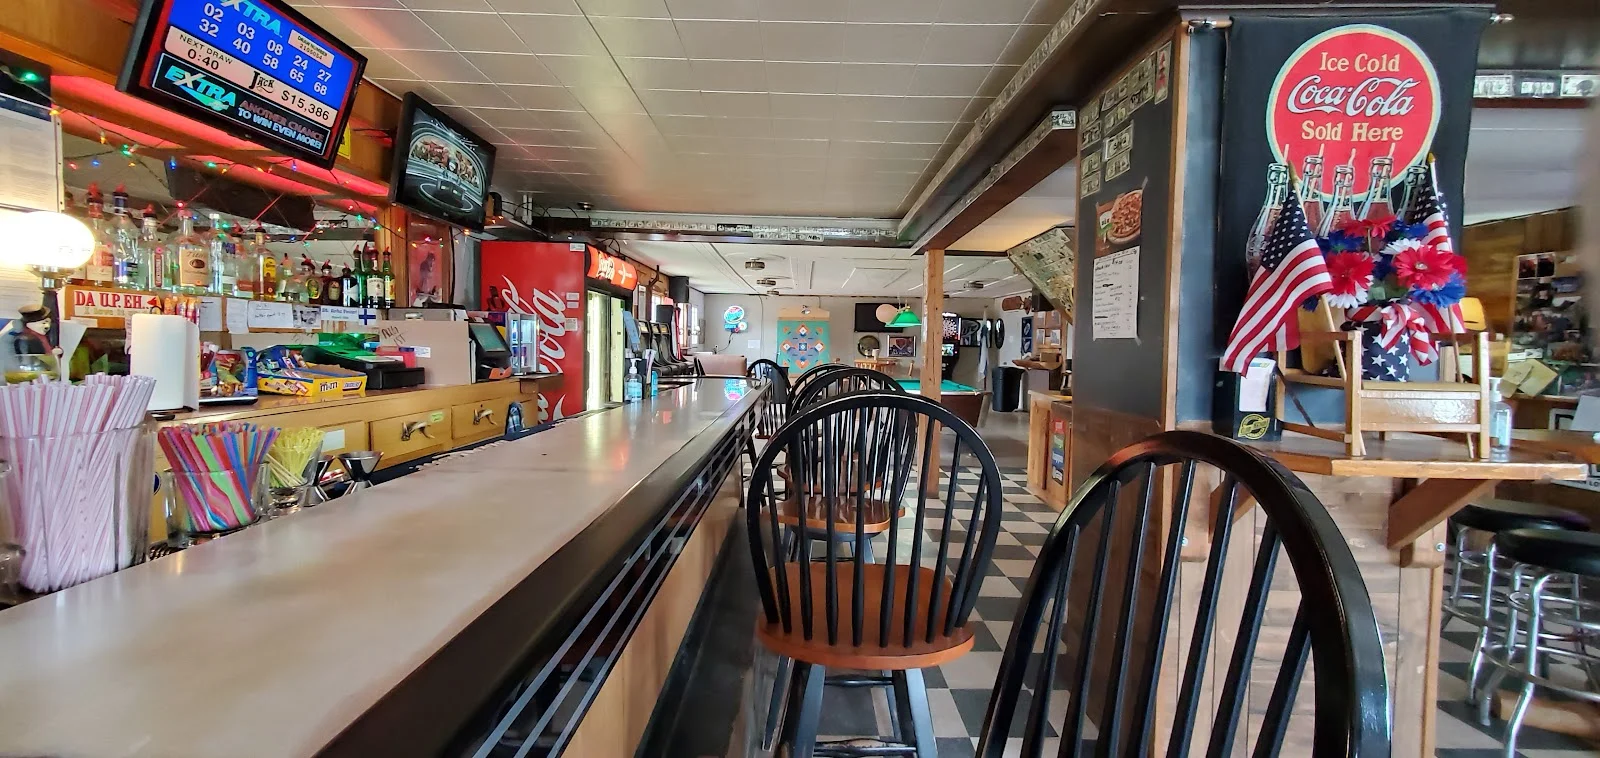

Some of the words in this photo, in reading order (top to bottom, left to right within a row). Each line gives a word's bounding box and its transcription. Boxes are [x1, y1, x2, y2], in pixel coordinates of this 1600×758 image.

[220, 0, 283, 37] XTRA
[179, 33, 205, 51] NEXT
[205, 46, 233, 65] DRAW
[199, 18, 220, 38] 32
[233, 37, 251, 54] 40
[262, 53, 279, 70] 58
[289, 67, 305, 84] 65
[313, 80, 328, 96] 68
[203, 2, 224, 23] 02
[237, 22, 255, 40] 03
[267, 39, 284, 56] 08
[292, 53, 309, 71] 24
[317, 68, 332, 83] 27
[186, 48, 220, 71] 0:40
[1319, 52, 1350, 72] Ice
[1354, 53, 1400, 73] Cold
[164, 65, 237, 107] EXTRA
[237, 107, 252, 121] TO
[252, 113, 273, 129] WIN
[272, 122, 296, 139] EVEN
[239, 100, 287, 126] ANOTHER
[288, 120, 325, 140] CHANCE
[1301, 120, 1343, 142] Sold
[1351, 122, 1404, 142] Here
[74, 291, 95, 307] DA
